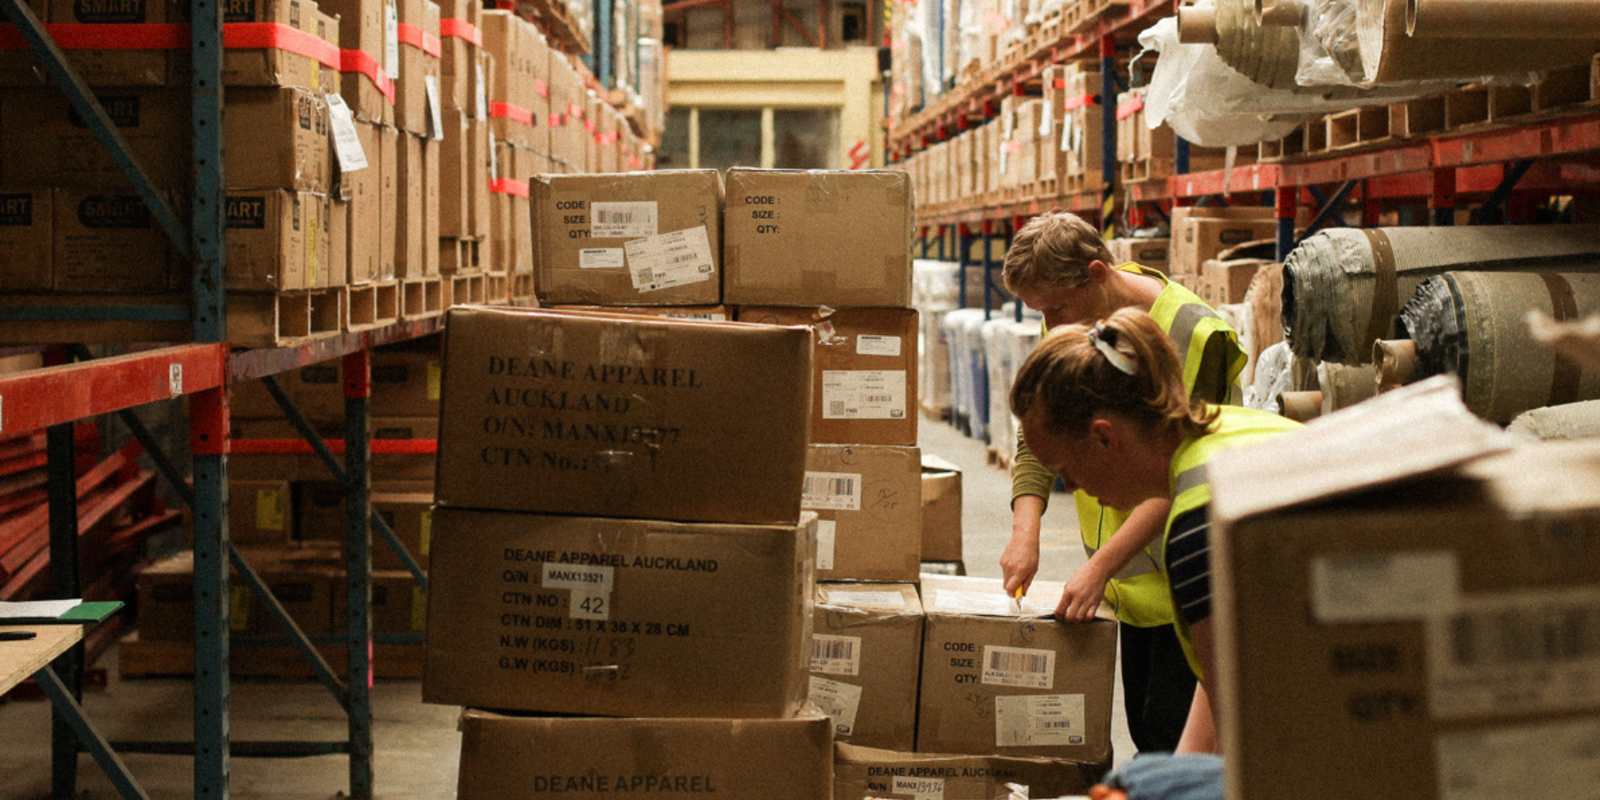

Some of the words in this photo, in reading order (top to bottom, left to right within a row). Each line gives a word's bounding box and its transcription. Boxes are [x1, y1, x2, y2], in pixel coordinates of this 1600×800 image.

[556, 201, 586, 210] CODE
[745, 196, 774, 205] CODE
[563, 215, 586, 224] SIZE
[751, 210, 774, 219] SIZE
[488, 356, 576, 381] DEANE
[582, 364, 704, 389] APPAREL
[486, 387, 634, 414] AUCKLAND
[483, 415, 535, 438] O/N:
[480, 445, 532, 467] CTN
[504, 548, 556, 563] DEANE
[559, 551, 629, 568] APPAREL
[633, 556, 719, 573] AUCKLAND
[502, 569, 529, 584] O/N
[548, 570, 604, 584] MANX13521
[501, 591, 532, 607] CTN
[536, 594, 559, 608] NO
[579, 596, 604, 615] 42
[501, 613, 531, 628] CTN
[535, 615, 562, 630] DIM
[576, 619, 591, 631] 51
[596, 620, 606, 633] X
[611, 621, 627, 634] 38
[631, 622, 641, 634] X
[645, 622, 662, 636] 28
[666, 623, 690, 637] CM
[499, 635, 529, 648] N.W
[532, 637, 575, 654] (KGS)
[944, 642, 975, 652] CODE
[499, 657, 529, 671] G.W
[532, 659, 575, 676] (KGS)
[950, 657, 974, 668] SIZE
[867, 766, 906, 777] DEANE
[907, 767, 959, 778] APPAREL
[533, 774, 610, 793] DEANE
[614, 775, 717, 793] APPAREL
